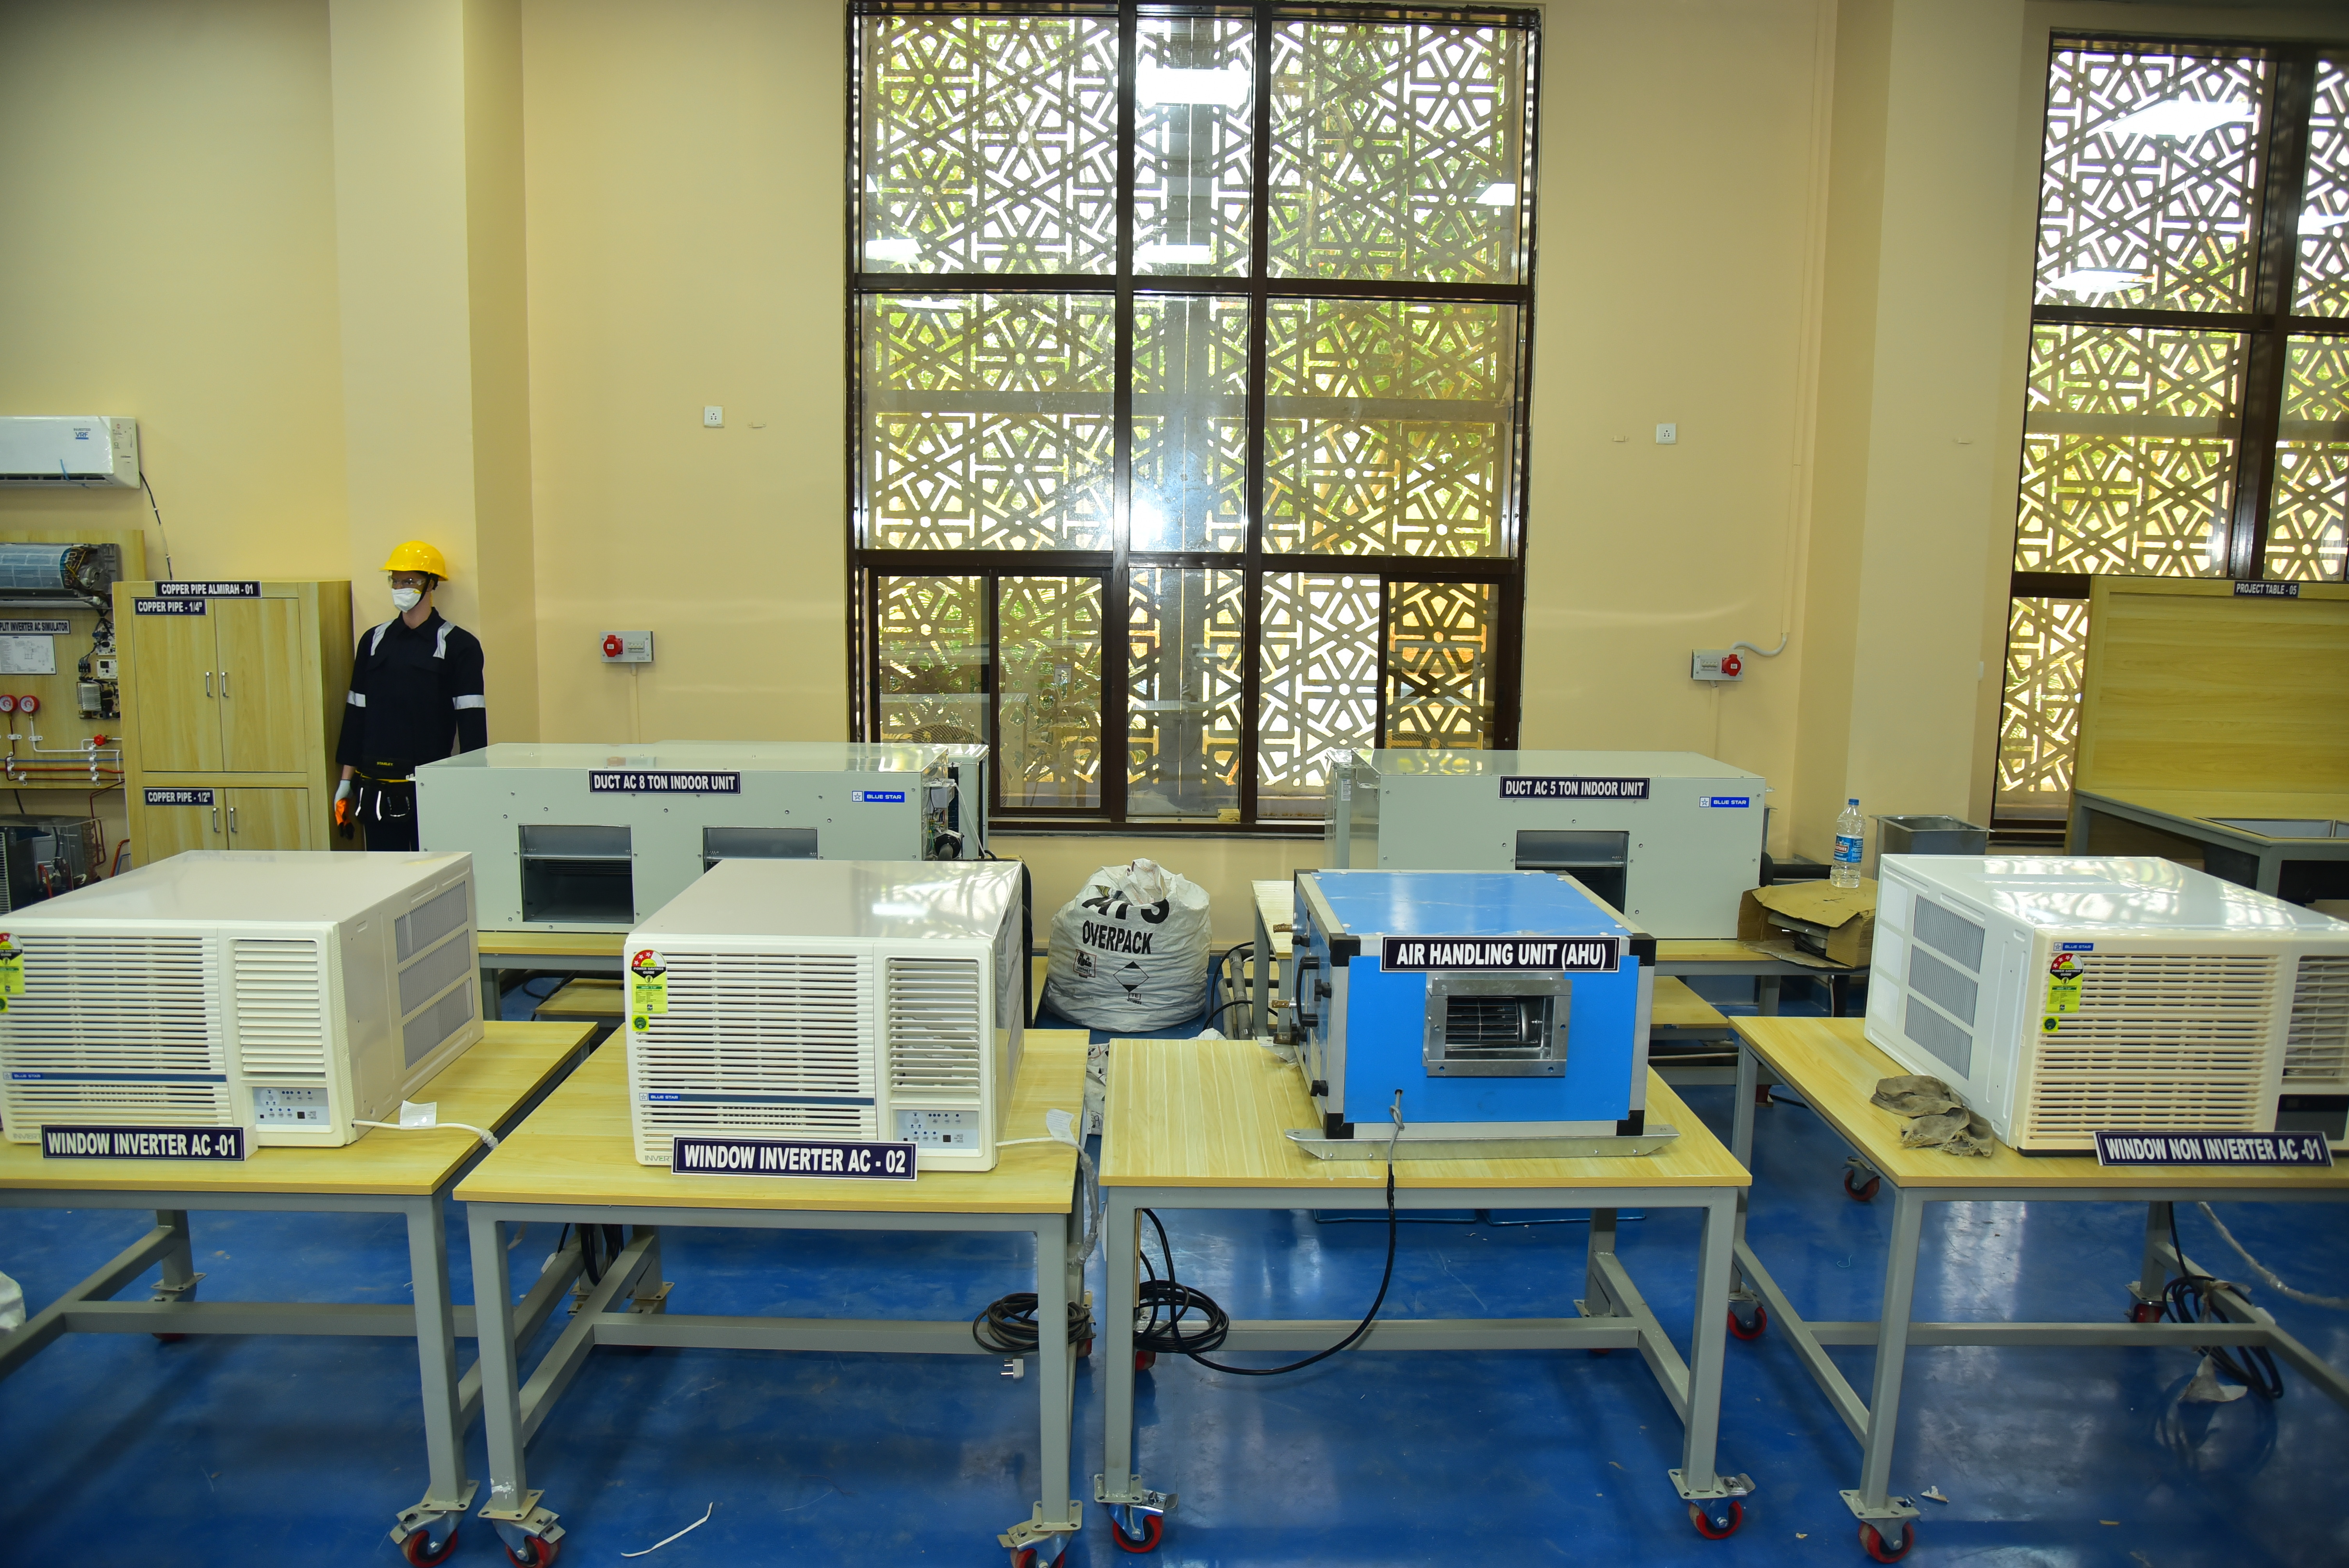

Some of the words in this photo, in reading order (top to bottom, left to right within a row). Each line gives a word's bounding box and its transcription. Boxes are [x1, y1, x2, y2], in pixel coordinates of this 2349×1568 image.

[162, 584, 189, 594] COPPER
[191, 584, 207, 594] PIPE
[209, 584, 240, 594] ALMIRAH
[245, 584, 253, 594] 01
[2236, 583, 2264, 593] PROJECT
[2265, 584, 2285, 594] TABLE
[2289, 586, 2297, 595] 05
[138, 602, 166, 612] COPPER
[168, 602, 184, 612] PIPE
[11, 622, 34, 631] INVERTER
[35, 622, 41, 631] AC
[42, 622, 68, 631] SIMULATOR
[594, 775, 620, 789] DUCT
[624, 775, 636, 789] AC
[639, 775, 645, 789] 8
[647, 775, 668, 789] TON
[671, 776, 709, 789] INDOOR
[711, 776, 735, 790] UNIT
[1506, 781, 1532, 795] DUCT
[1534, 781, 1547, 795] AC
[1550, 781, 1556, 795] 5
[1559, 782, 1578, 795] TON
[1581, 782, 1618, 796] INDOOR
[1621, 782, 1644, 796] UNIT
[148, 792, 175, 802] COPPER
[176, 792, 192, 802] PIPE
[1082, 920, 1153, 954] OVERPACK
[1397, 944, 1425, 965] AIR
[1429, 944, 1513, 965] HANDLING
[1518, 944, 1557, 965] UNIT
[1561, 944, 1606, 970] (AHU)
[48, 1132, 110, 1154] WINDOW
[114, 1133, 187, 1155] INVERTER
[191, 1134, 211, 1156] AC
[2105, 1139, 2165, 1160] WINDOW
[2168, 1139, 2202, 1160] NON
[2203, 1139, 2277, 1160] INVERTER
[2278, 1139, 2299, 1160] AC
[685, 1145, 755, 1169] WINDOW
[760, 1147, 843, 1171] INVERTER
[848, 1149, 871, 1172] AC
[886, 1150, 905, 1173] 02
